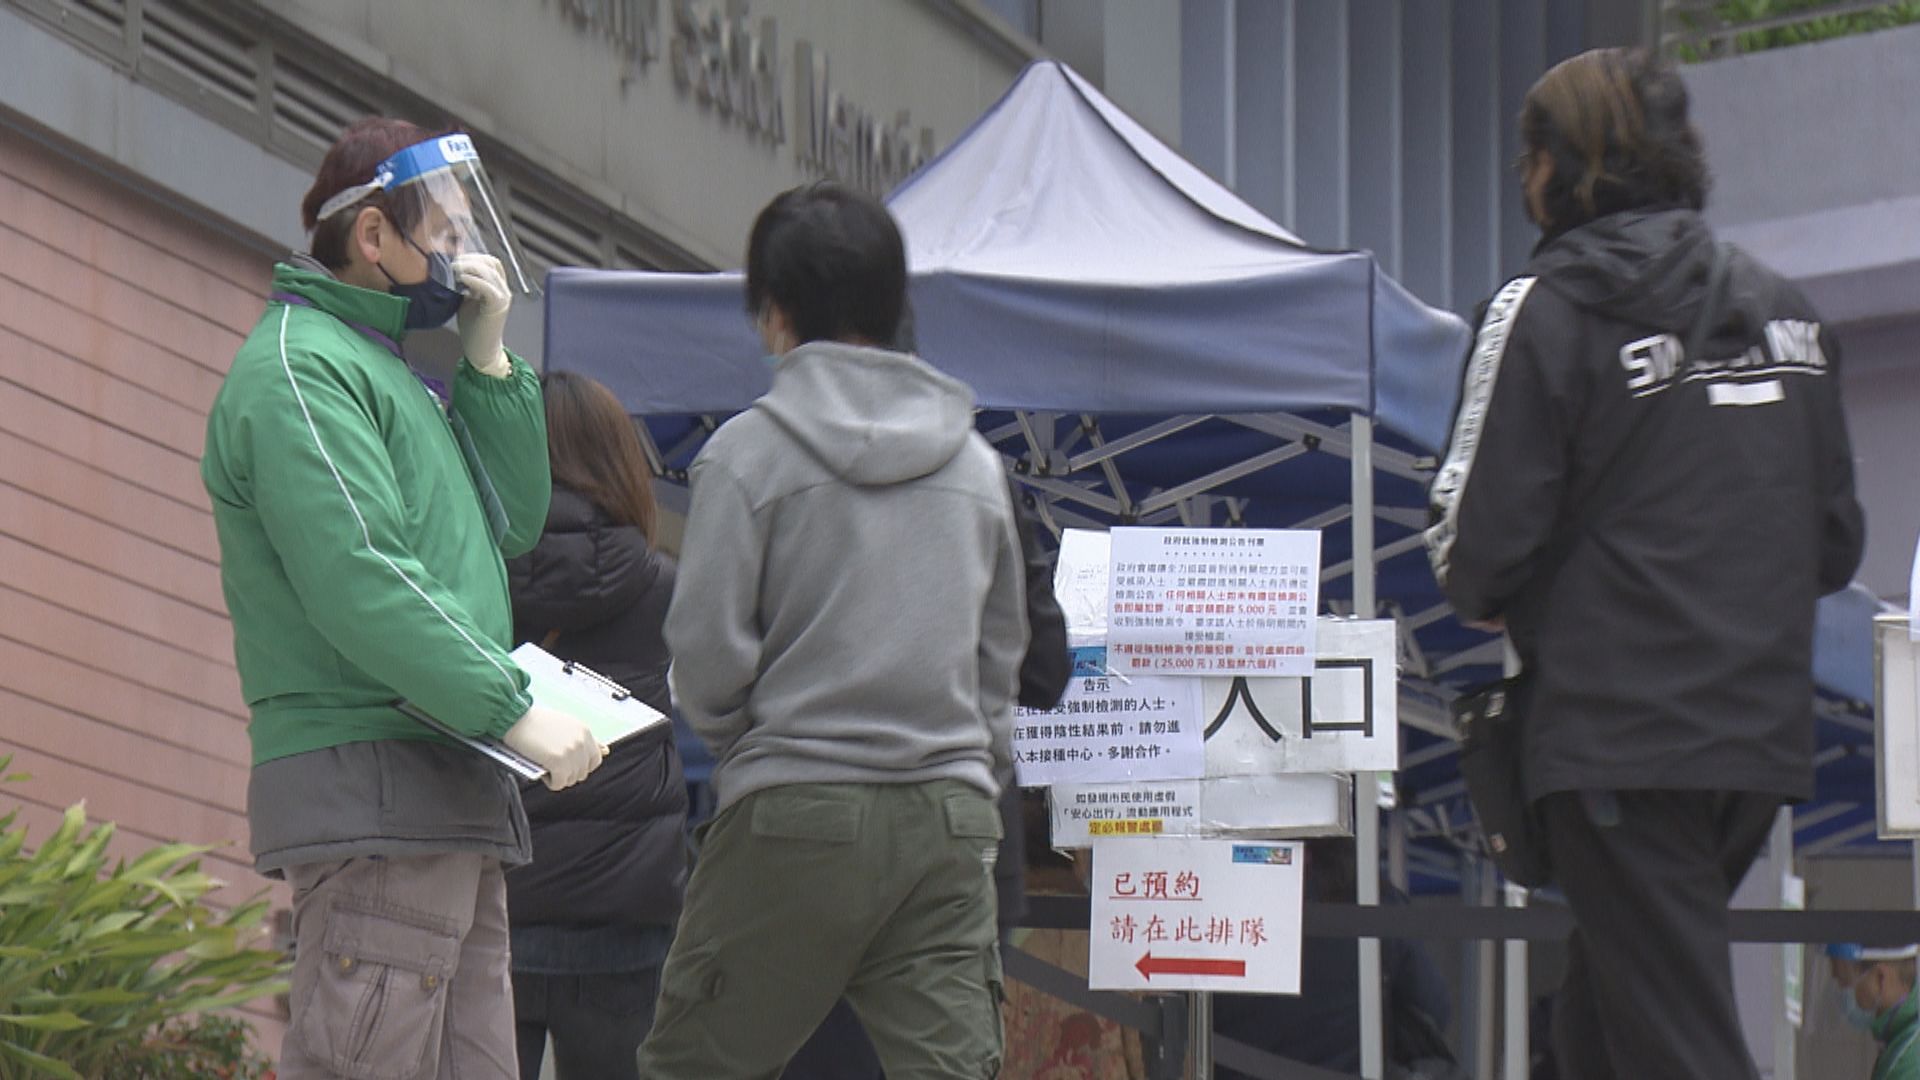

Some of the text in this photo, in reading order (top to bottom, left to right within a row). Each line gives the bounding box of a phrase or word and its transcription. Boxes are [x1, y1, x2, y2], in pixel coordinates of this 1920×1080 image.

[1083, 678, 1110, 691] 告示
[1075, 791, 1176, 803] 如發現市民使用虛假
[1114, 871, 1200, 898] 已預約
[1109, 916, 1268, 946] 請在此排隊
